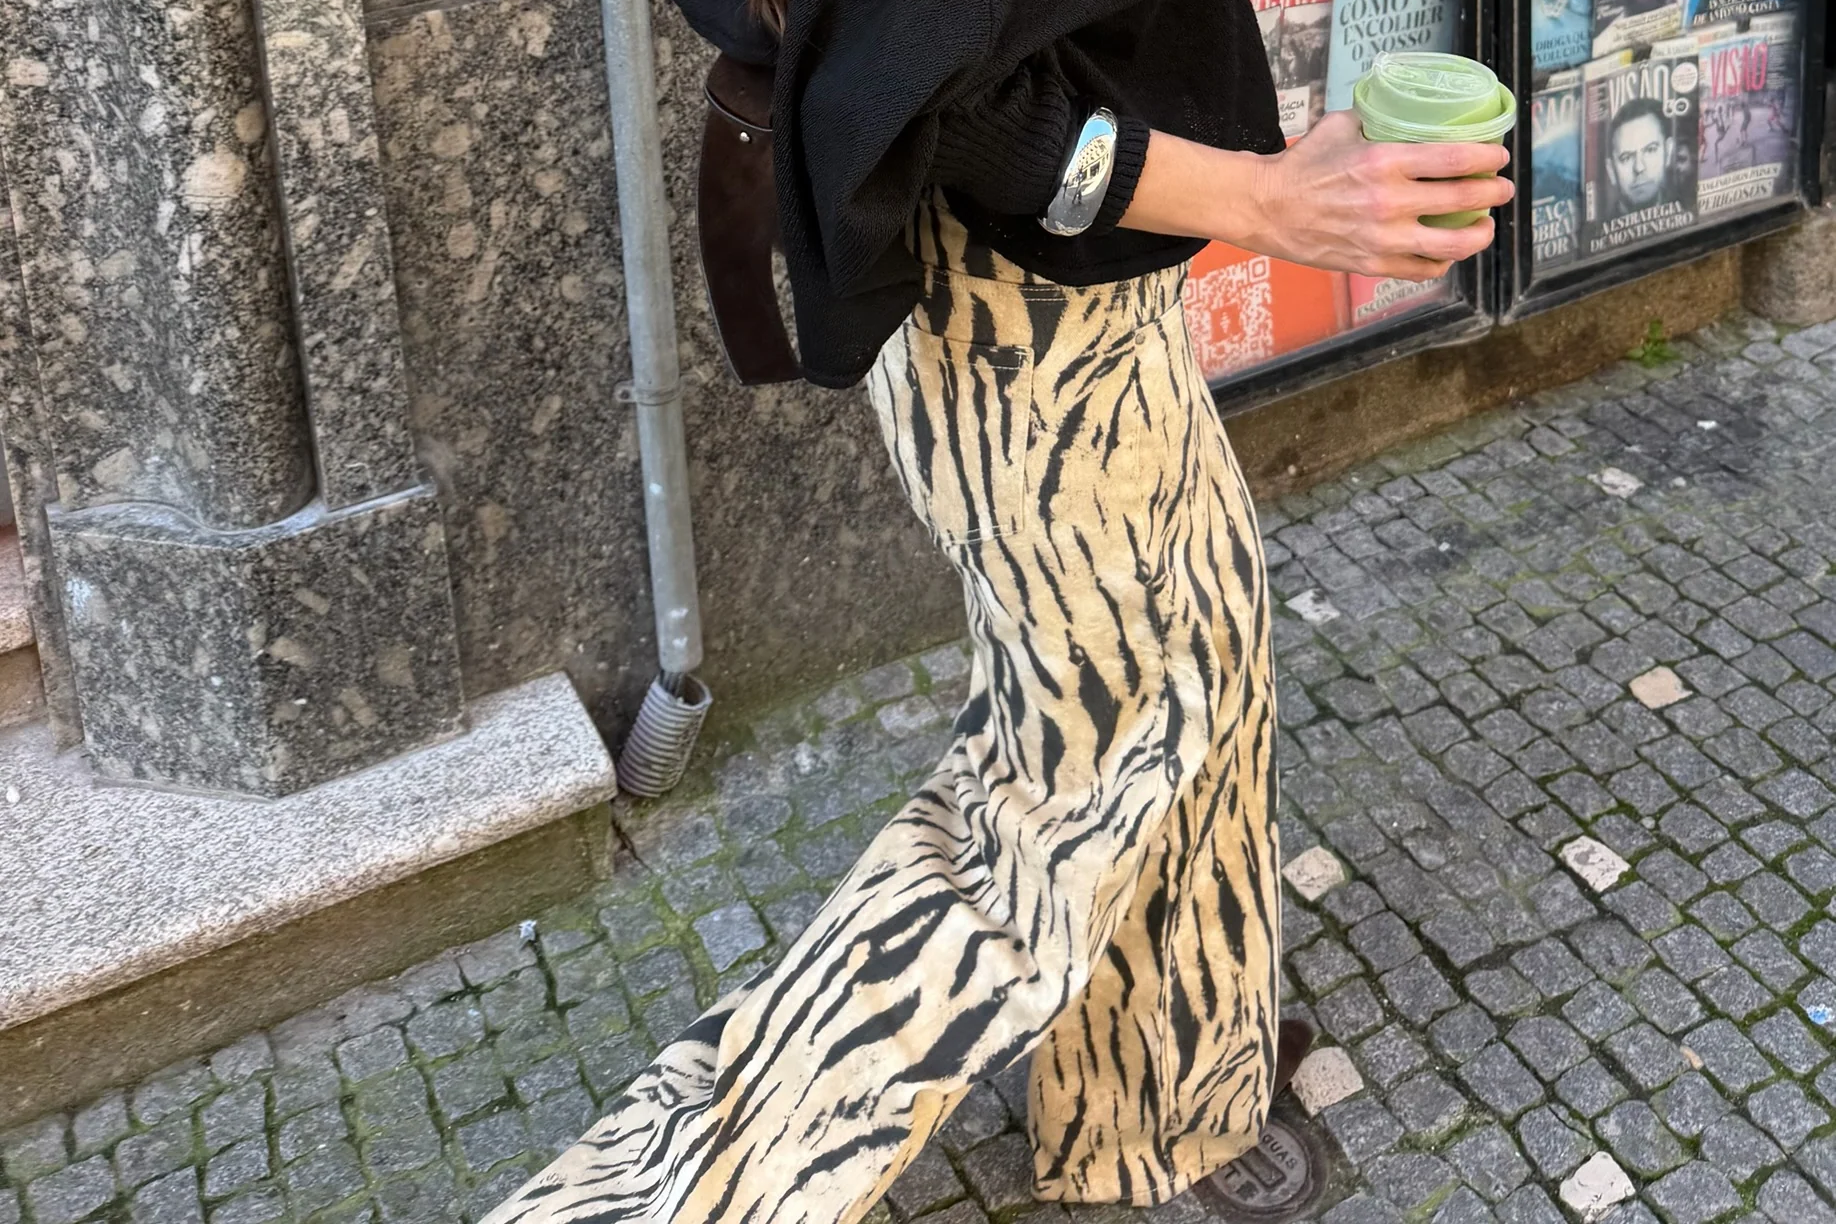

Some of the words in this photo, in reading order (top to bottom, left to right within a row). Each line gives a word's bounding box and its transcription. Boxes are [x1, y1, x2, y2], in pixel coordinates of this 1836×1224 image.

[1344, 5, 1444, 46] ENCOLHER
[1351, 43, 1364, 63] O
[1370, 27, 1432, 54] NOSSO
[1608, 60, 1670, 120] VISÃO
[1590, 236, 1607, 253] DE
[1608, 211, 1695, 246] MONTENEGRO
[1611, 199, 1684, 231] ESTRATÉGIA
